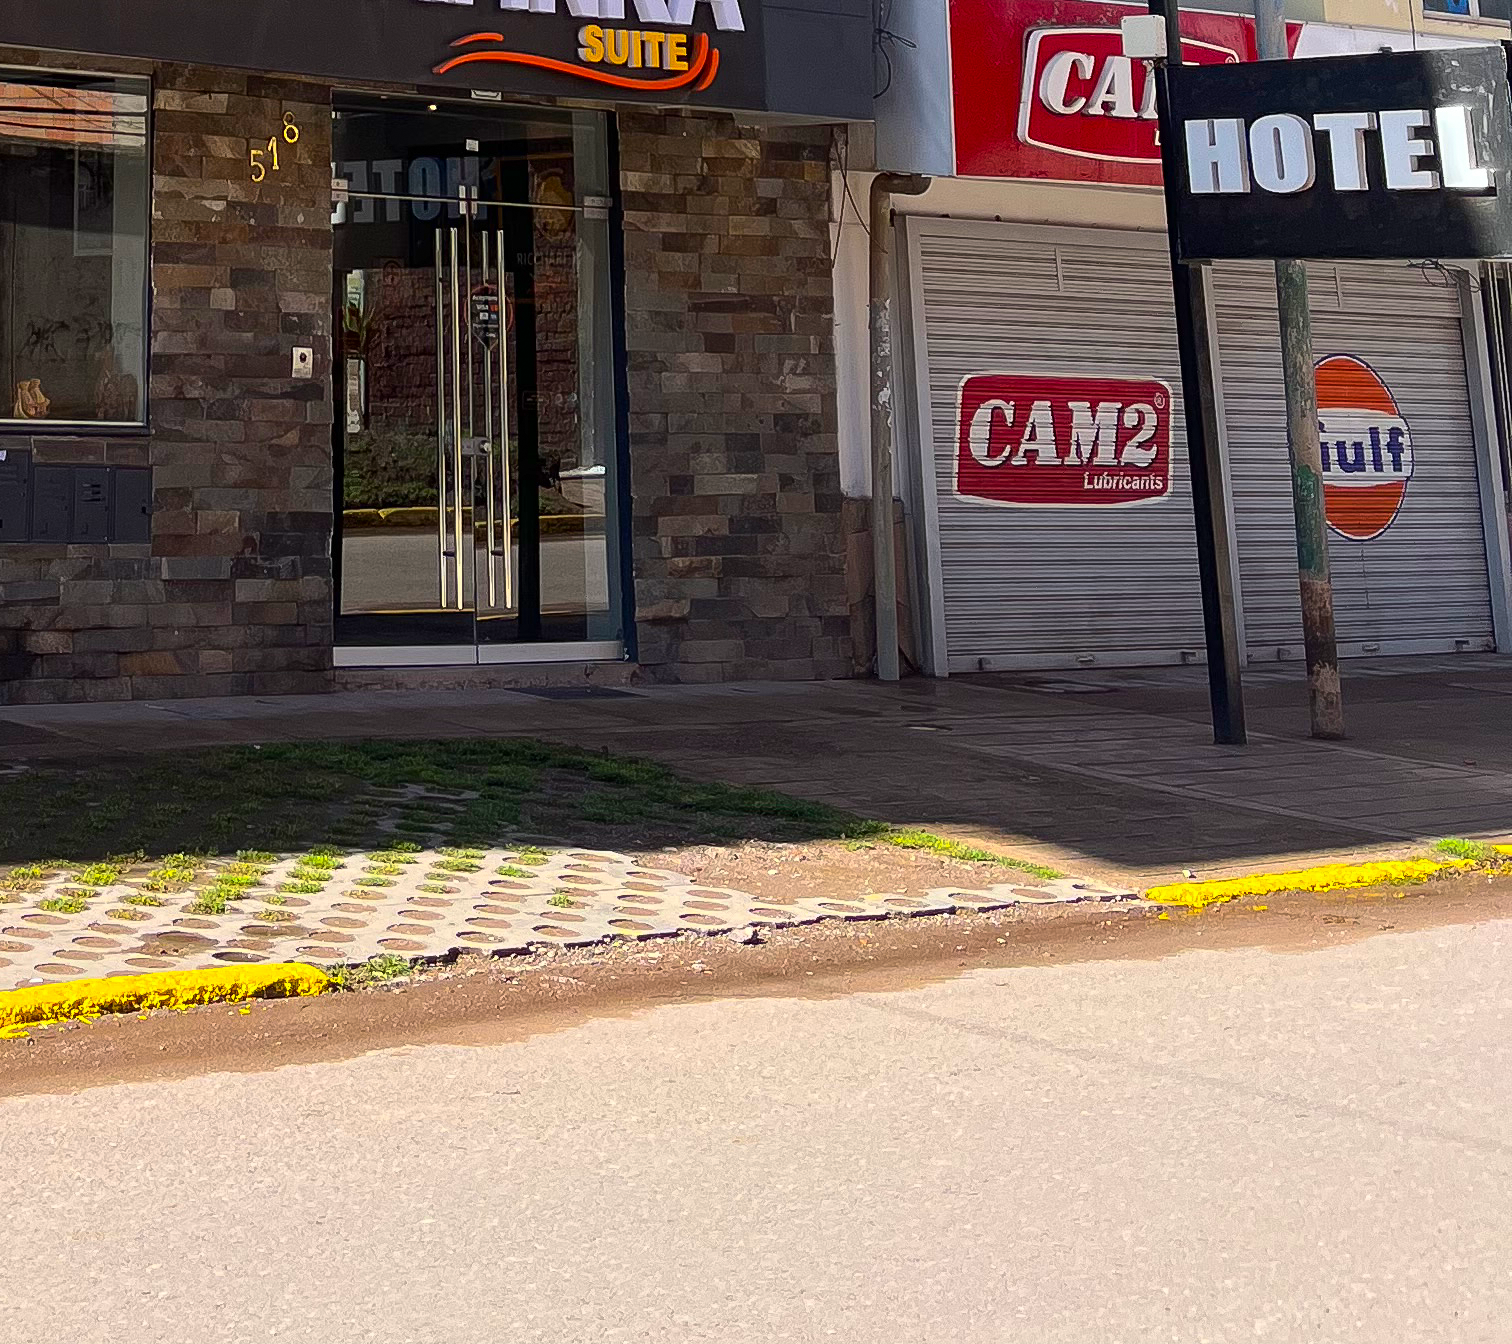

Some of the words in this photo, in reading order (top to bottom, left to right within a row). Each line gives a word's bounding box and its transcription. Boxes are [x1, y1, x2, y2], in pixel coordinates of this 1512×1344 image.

[578, 23, 689, 72] SUITE
[250, 111, 299, 182] 518
[1185, 106, 1496, 195] HOTEL
[968, 399, 1158, 469] CAM2
[1083, 471, 1164, 491] Lubricants
